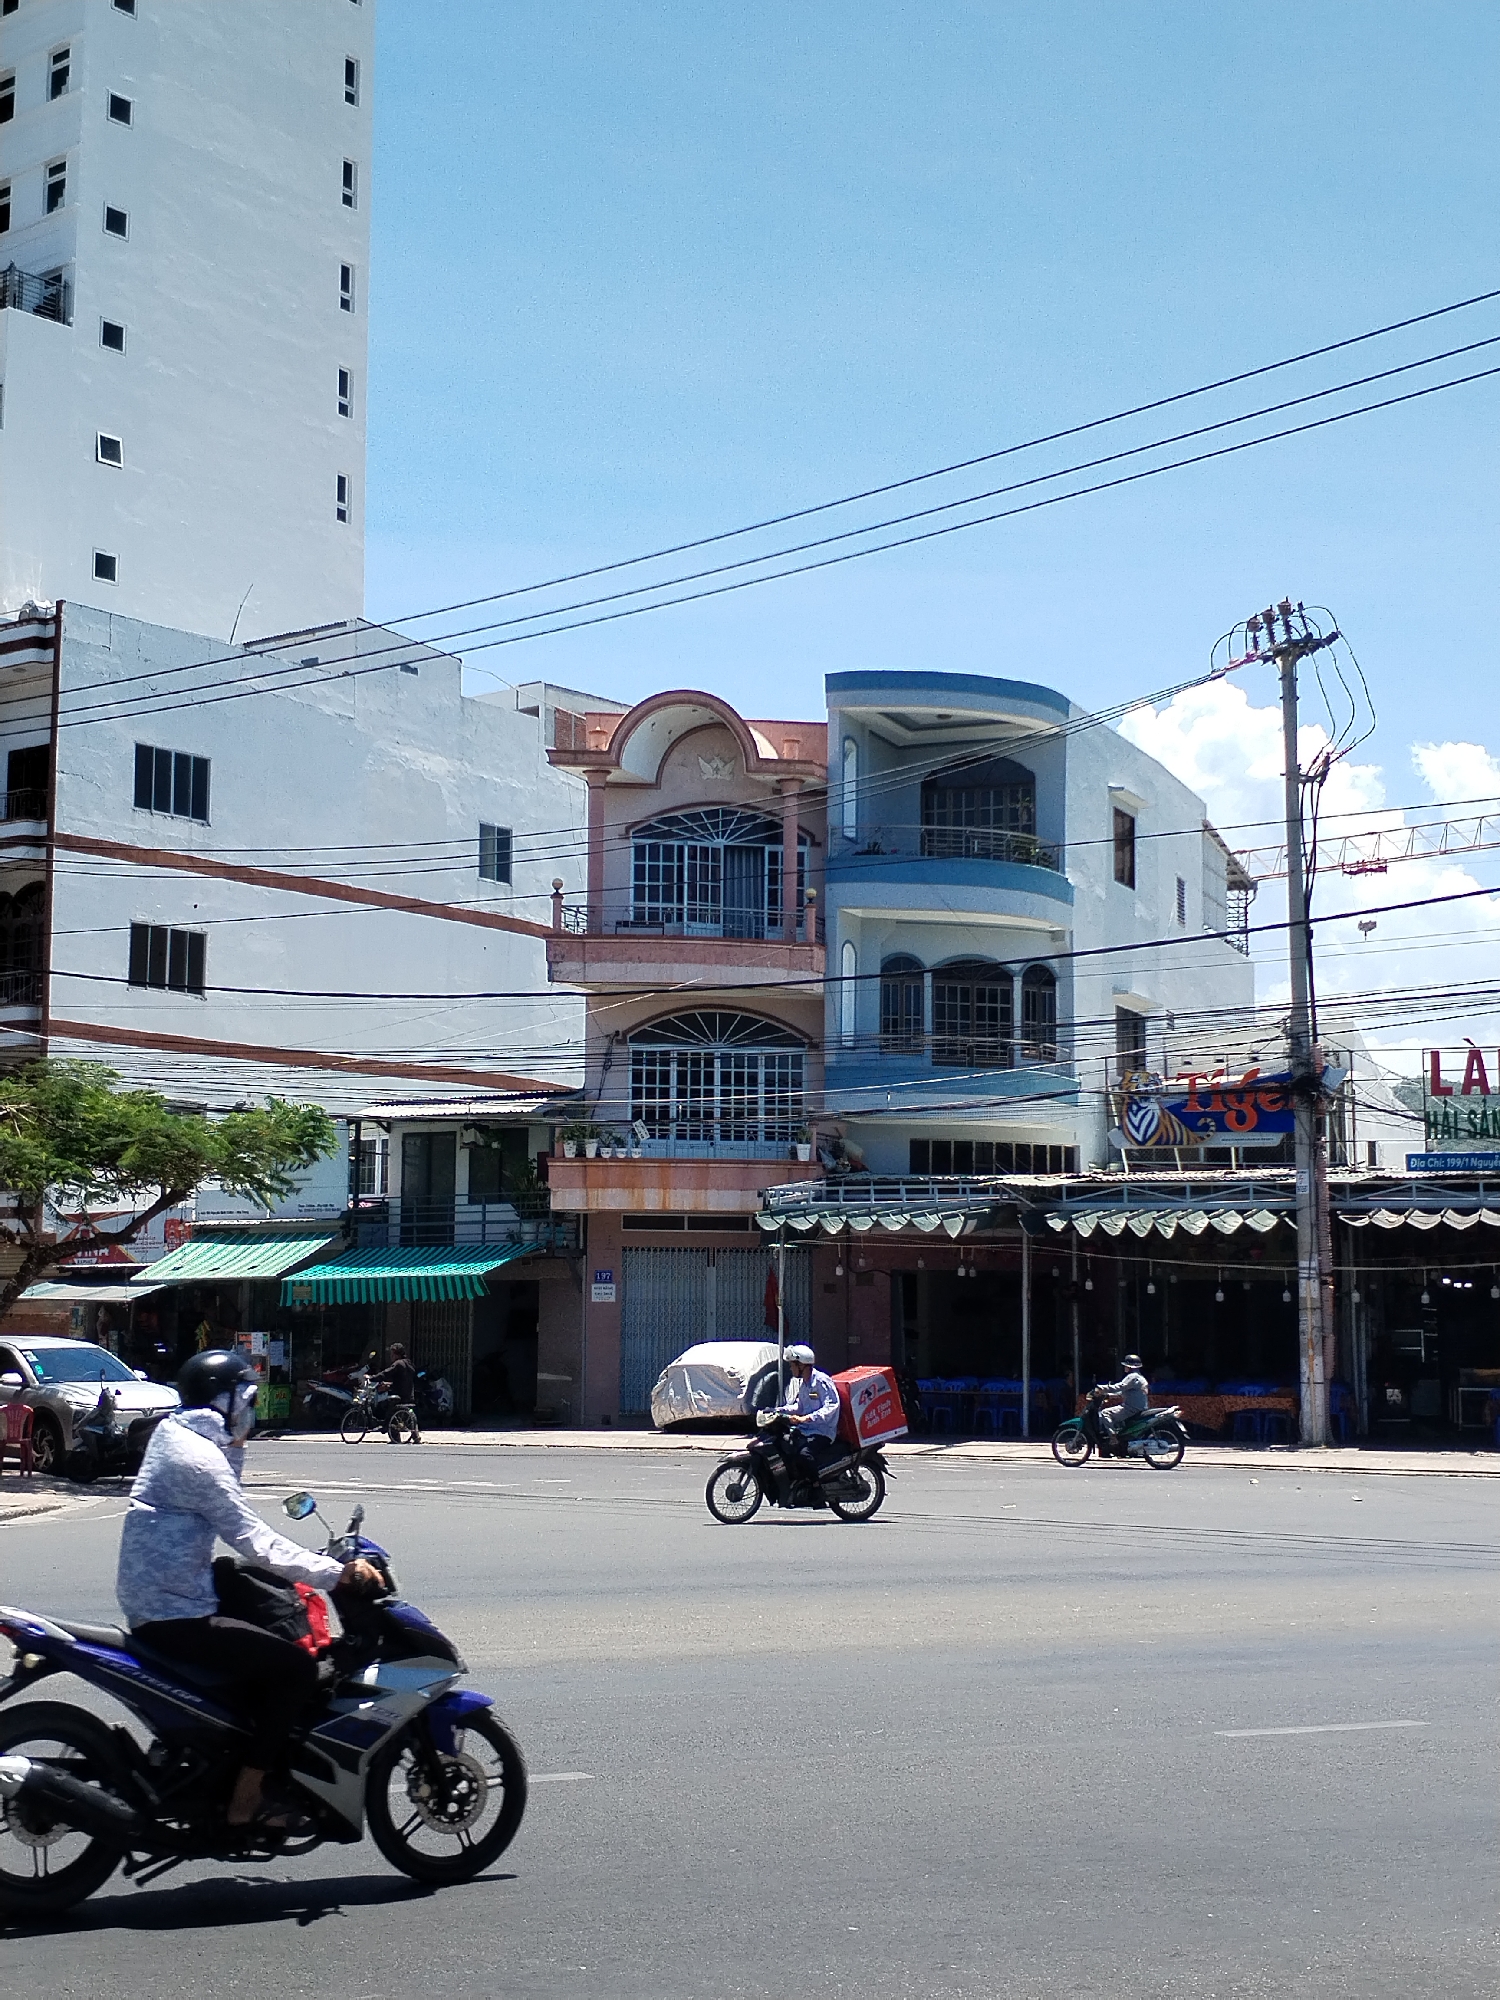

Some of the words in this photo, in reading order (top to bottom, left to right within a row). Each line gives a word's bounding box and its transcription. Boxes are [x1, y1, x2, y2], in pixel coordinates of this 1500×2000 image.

[1430, 1037, 1500, 1096] LÀ
[1410, 1157, 1426, 1170] Địa
[1446, 1157, 1469, 1170] 199/1
[596, 1272, 611, 1280] 197
